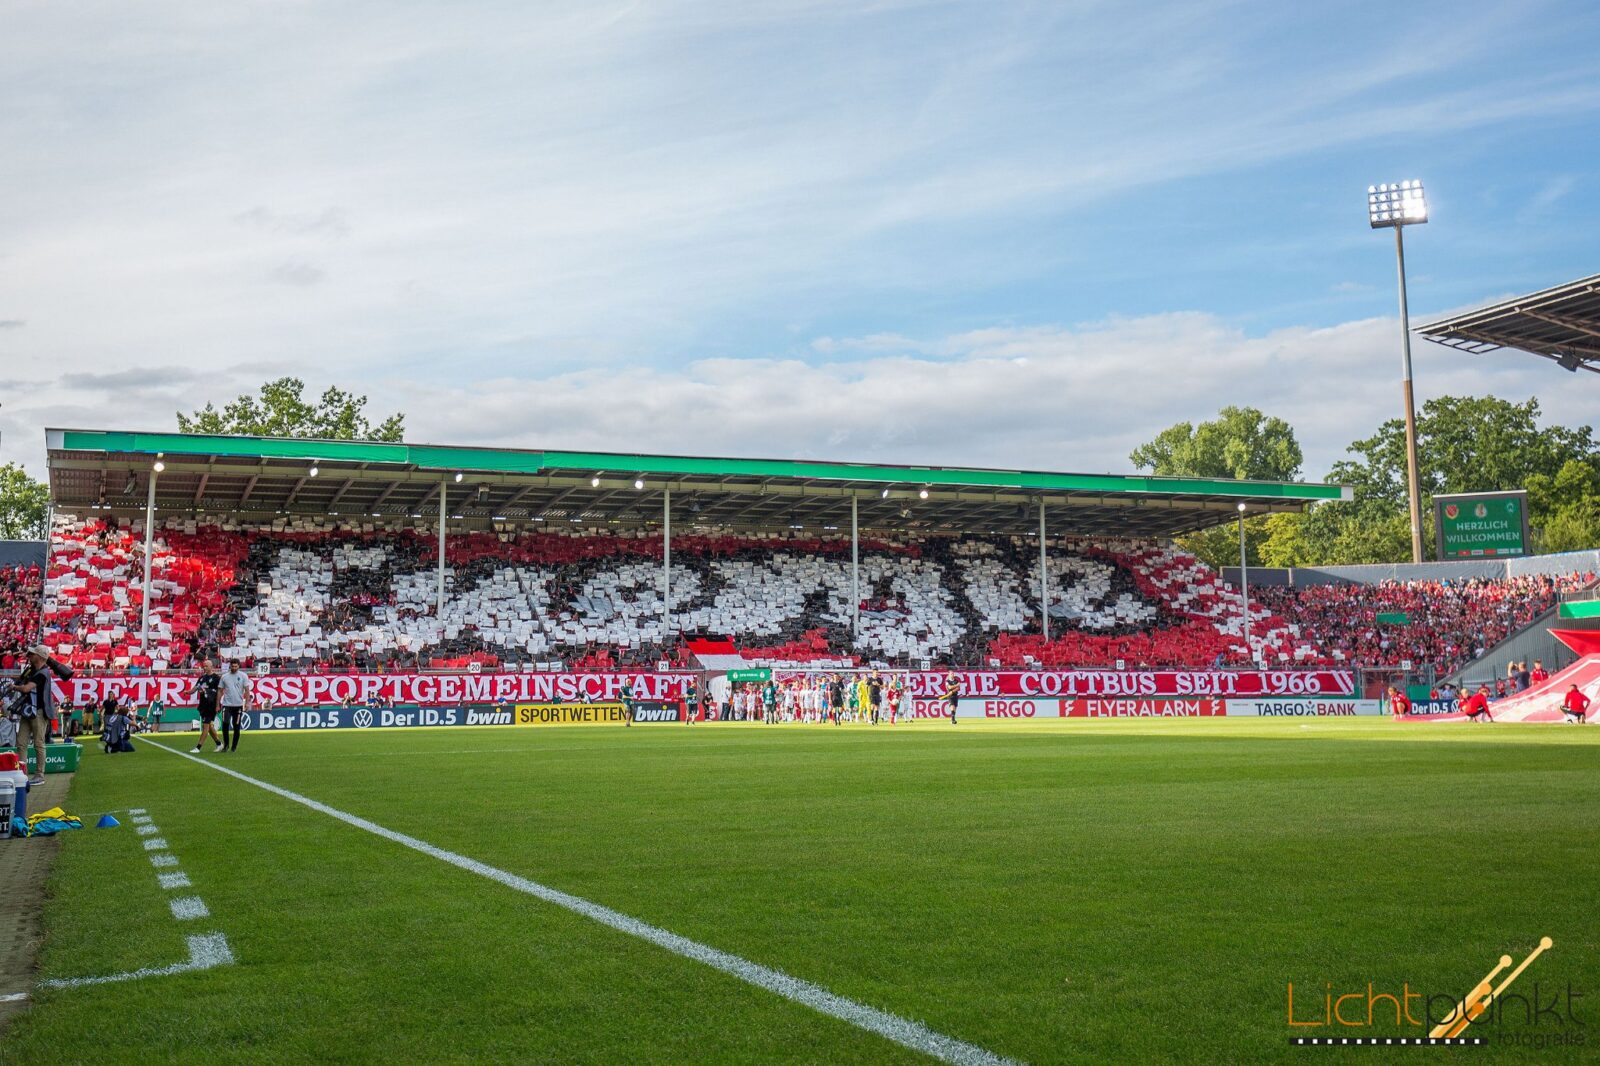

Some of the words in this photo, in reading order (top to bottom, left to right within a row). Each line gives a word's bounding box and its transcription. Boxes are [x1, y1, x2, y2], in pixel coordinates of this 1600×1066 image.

[1456, 520, 1508, 531] HERZLICH
[1446, 532, 1520, 543] WILLKOMMEN
[259, 664, 268, 673] 19
[471, 663, 480, 672] 20
[660, 662, 668, 670] 21
[922, 662, 930, 670] 22
[1020, 671, 1157, 696] COTTBUS
[1176, 671, 1240, 695] SEIT
[1258, 671, 1321, 694] 1966
[466, 707, 511, 725] bwin
[520, 706, 627, 723] SPORTWETTEN
[635, 705, 678, 721] bwin
[985, 700, 1036, 718] ERGO
[1087, 700, 1200, 717] FLYERALARM
[1411, 703, 1428, 714] Der
[1429, 702, 1448, 714] ID.5
[260, 713, 296, 729] Der
[300, 710, 340, 728] ID.5
[381, 707, 415, 727] Der
[419, 708, 457, 726] ID.5
